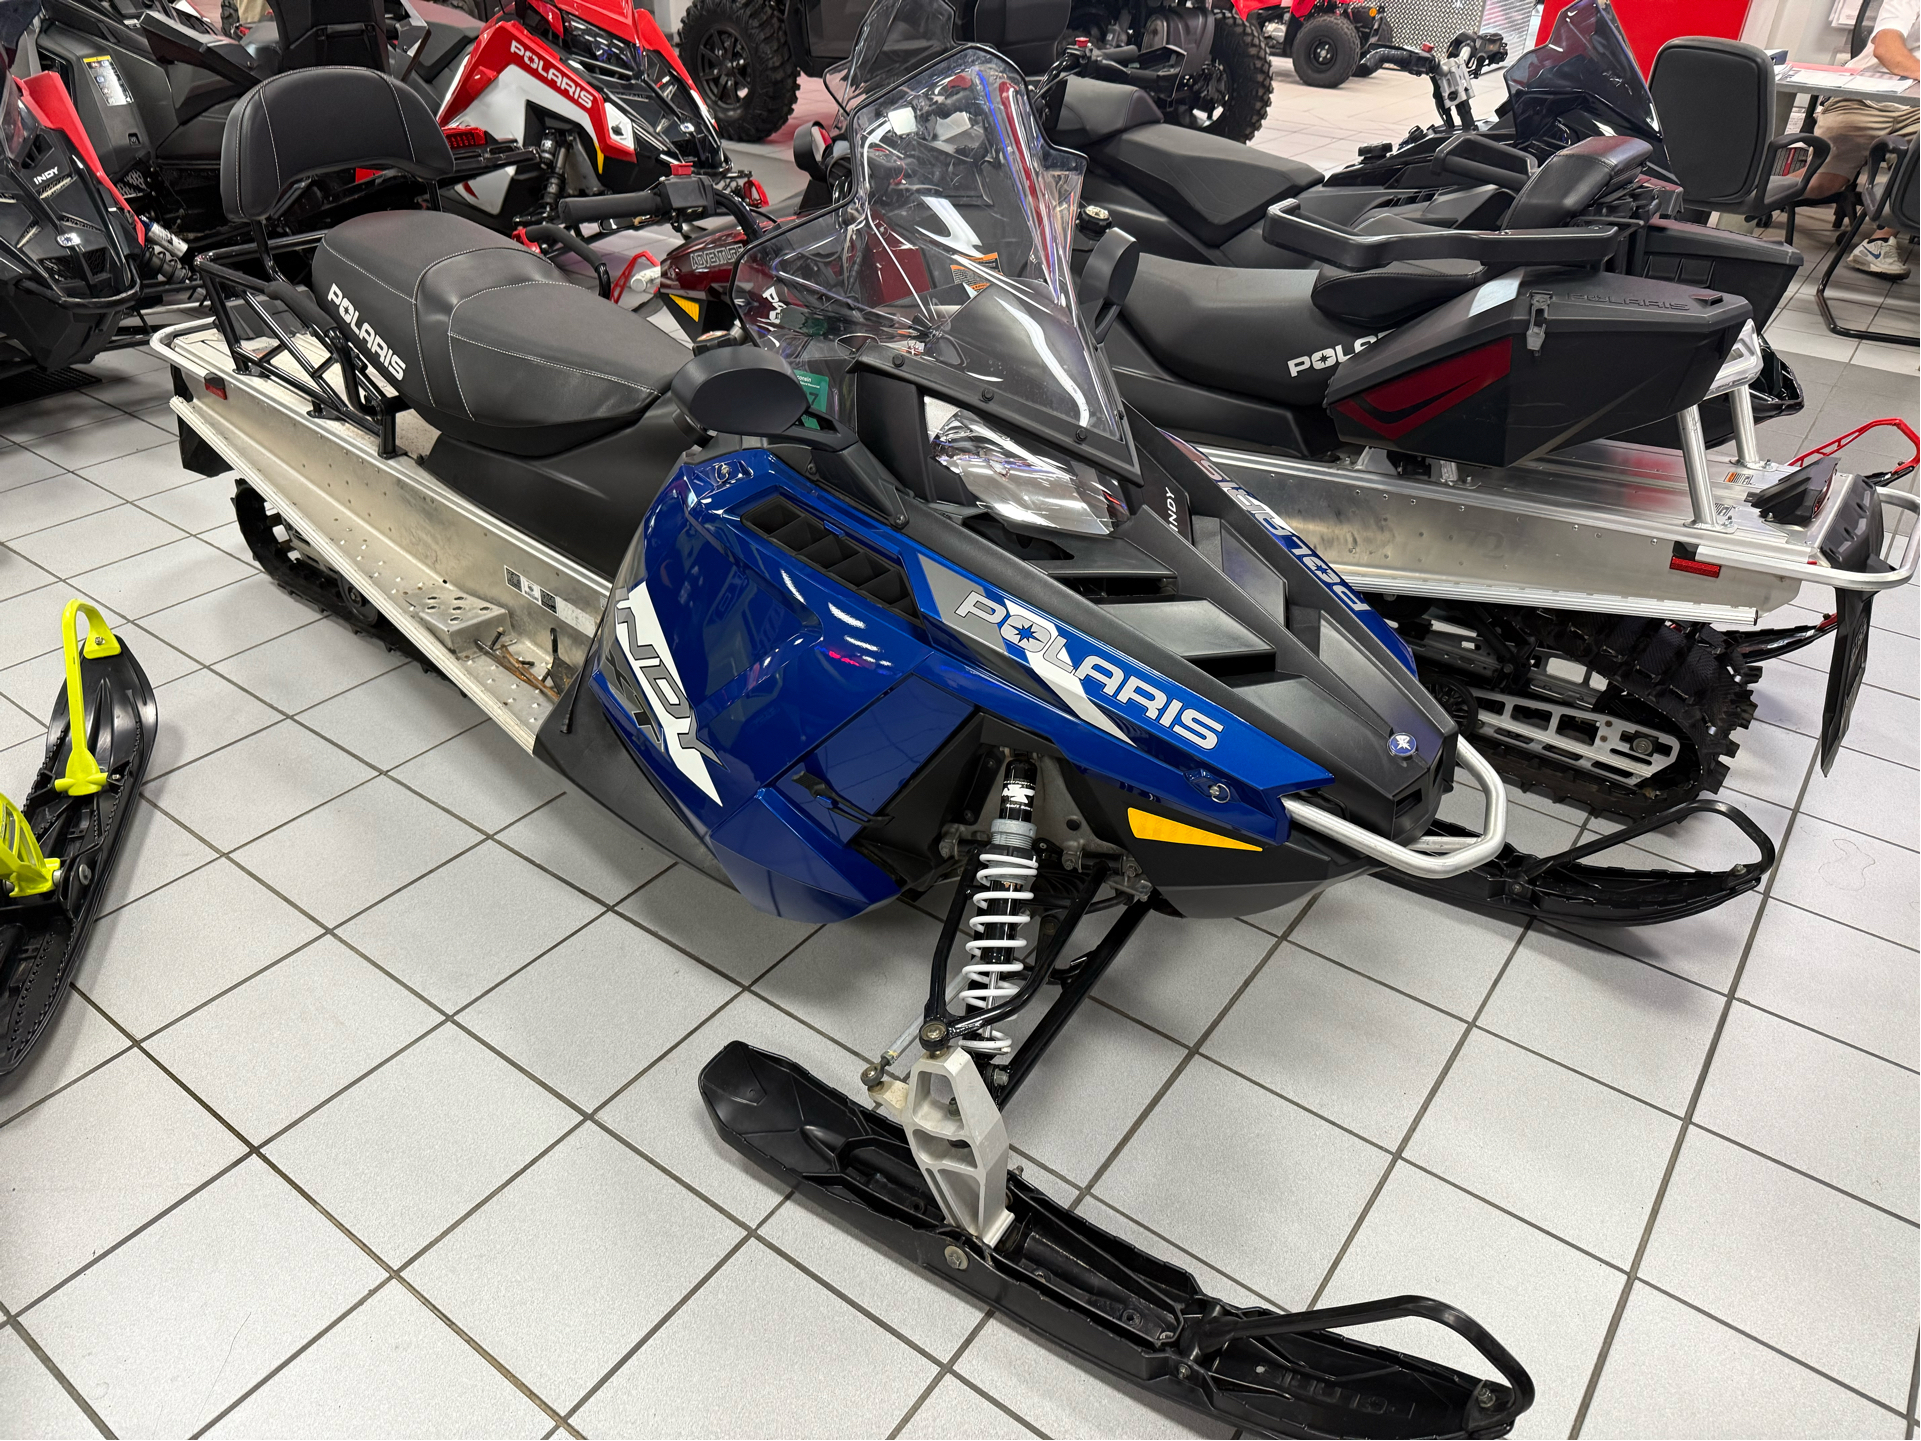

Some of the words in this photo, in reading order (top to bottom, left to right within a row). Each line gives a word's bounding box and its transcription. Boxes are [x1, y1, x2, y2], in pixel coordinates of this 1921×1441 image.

[510, 39, 593, 109] POLARIS
[33, 166, 59, 185] INDY
[327, 282, 407, 381] POLARIS
[1565, 292, 1690, 311] POLARIS
[1287, 328, 1396, 378] POLA
[1165, 486, 1179, 532] INDY
[1194, 458, 1373, 612] POLARIS
[615, 586, 725, 767] INDY
[954, 589, 1225, 751] POLARIS
